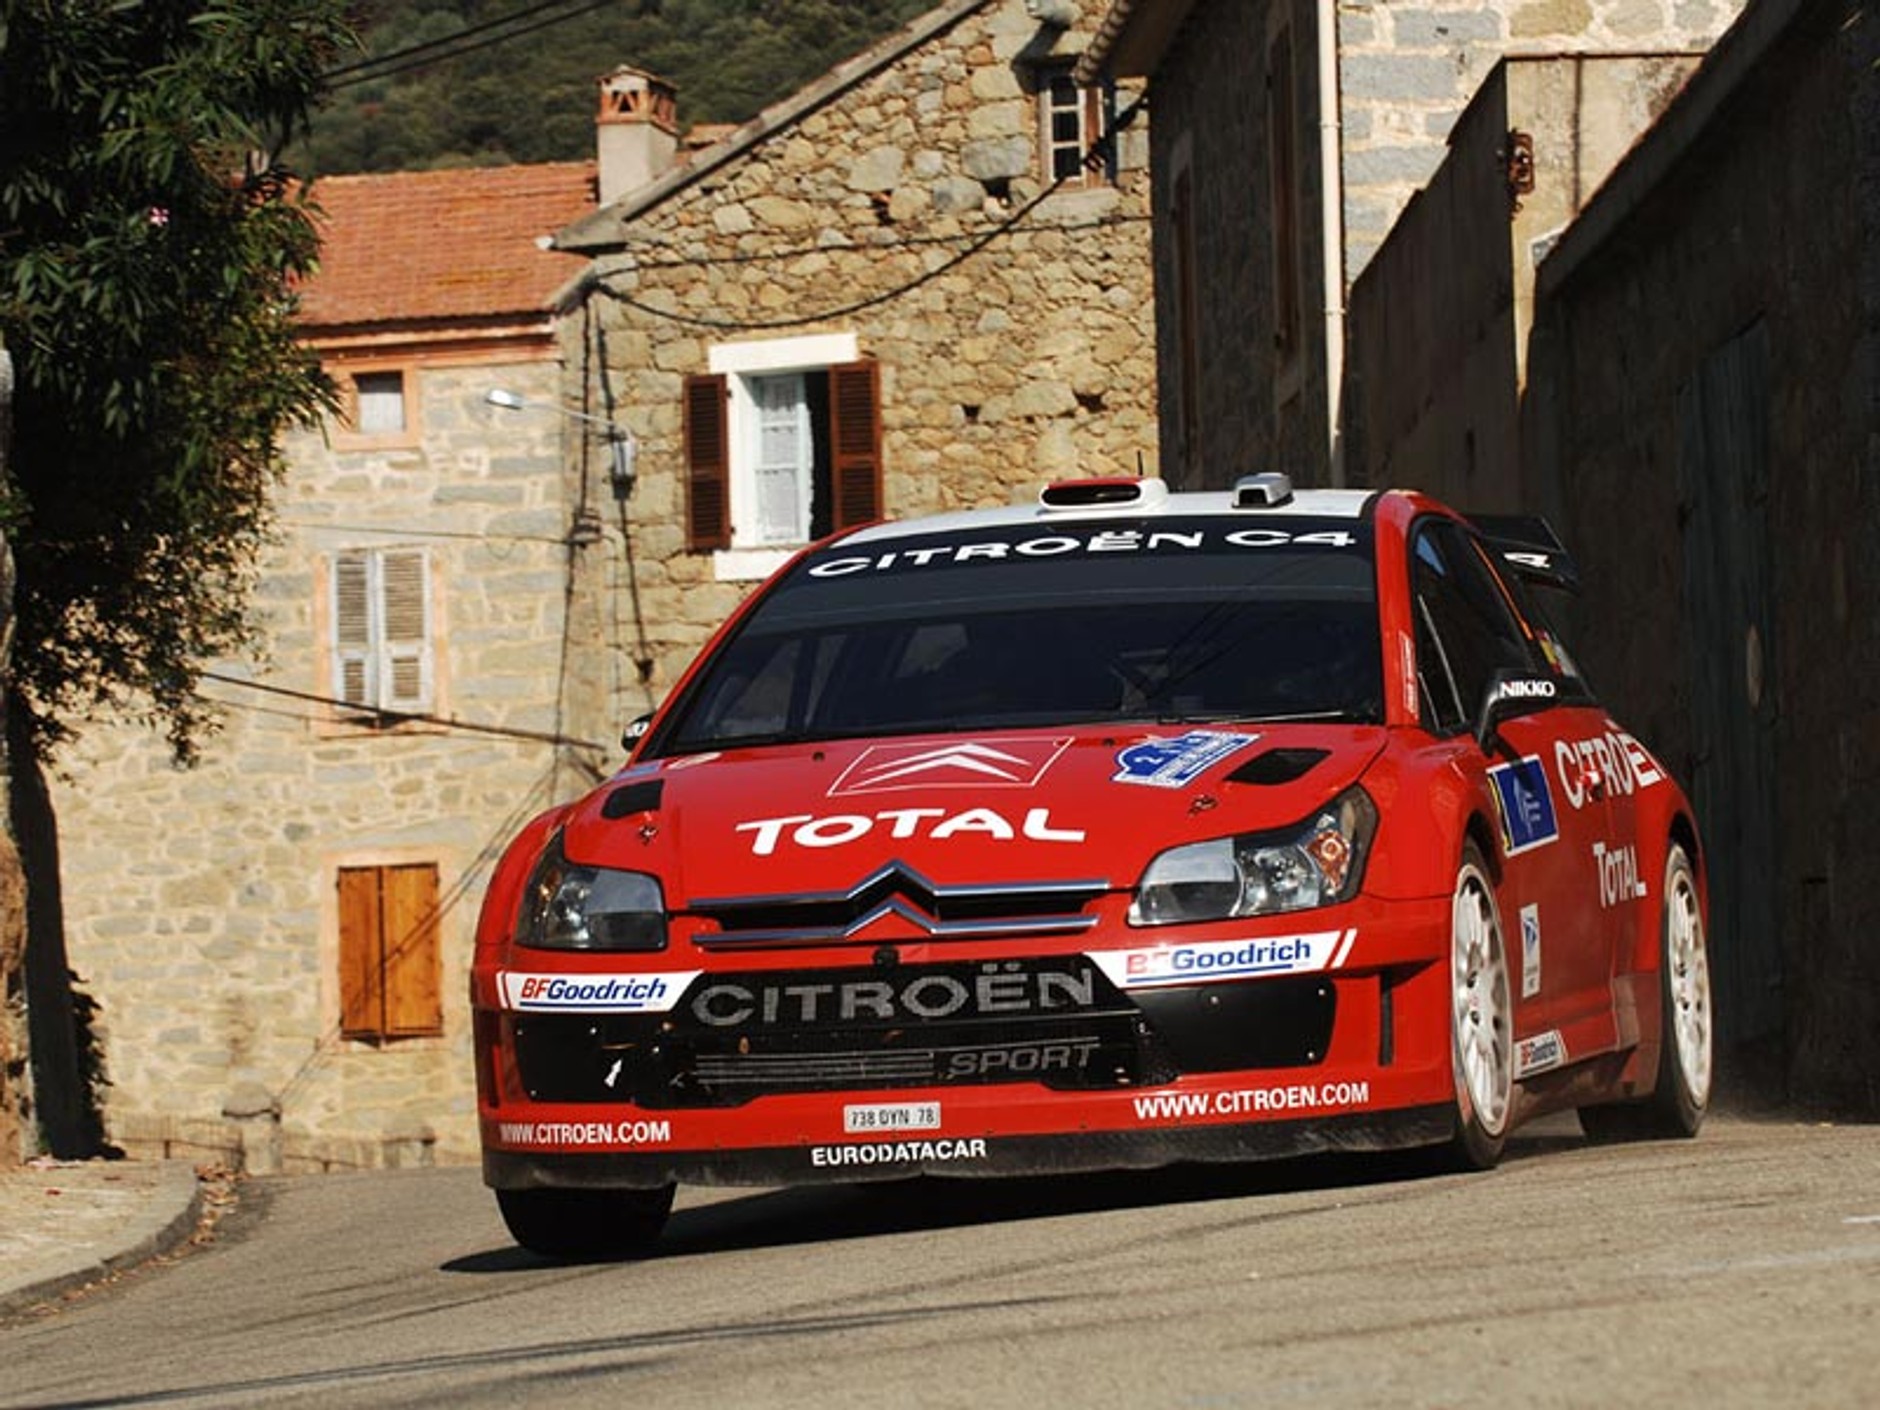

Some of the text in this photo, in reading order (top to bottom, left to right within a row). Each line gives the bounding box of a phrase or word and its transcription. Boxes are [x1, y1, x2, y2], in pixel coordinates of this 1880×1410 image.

[808, 529, 1356, 578] CITROËN C4
[1499, 680, 1555, 698] NIKKO
[735, 807, 1085, 856] TOTAL
[1592, 841, 1647, 908] TOTAL
[521, 976, 667, 1000] BFGoodrich
[691, 962, 1094, 1027] CITROËN
[948, 1043, 1100, 1075] SPORT
[916, 1106, 935, 1125] 78
[1133, 1081, 1369, 1120] WWW.CITROEN.COM
[499, 1120, 671, 1145] WWW.CITROEN.COM
[811, 1138, 987, 1167] EURODATACAR
